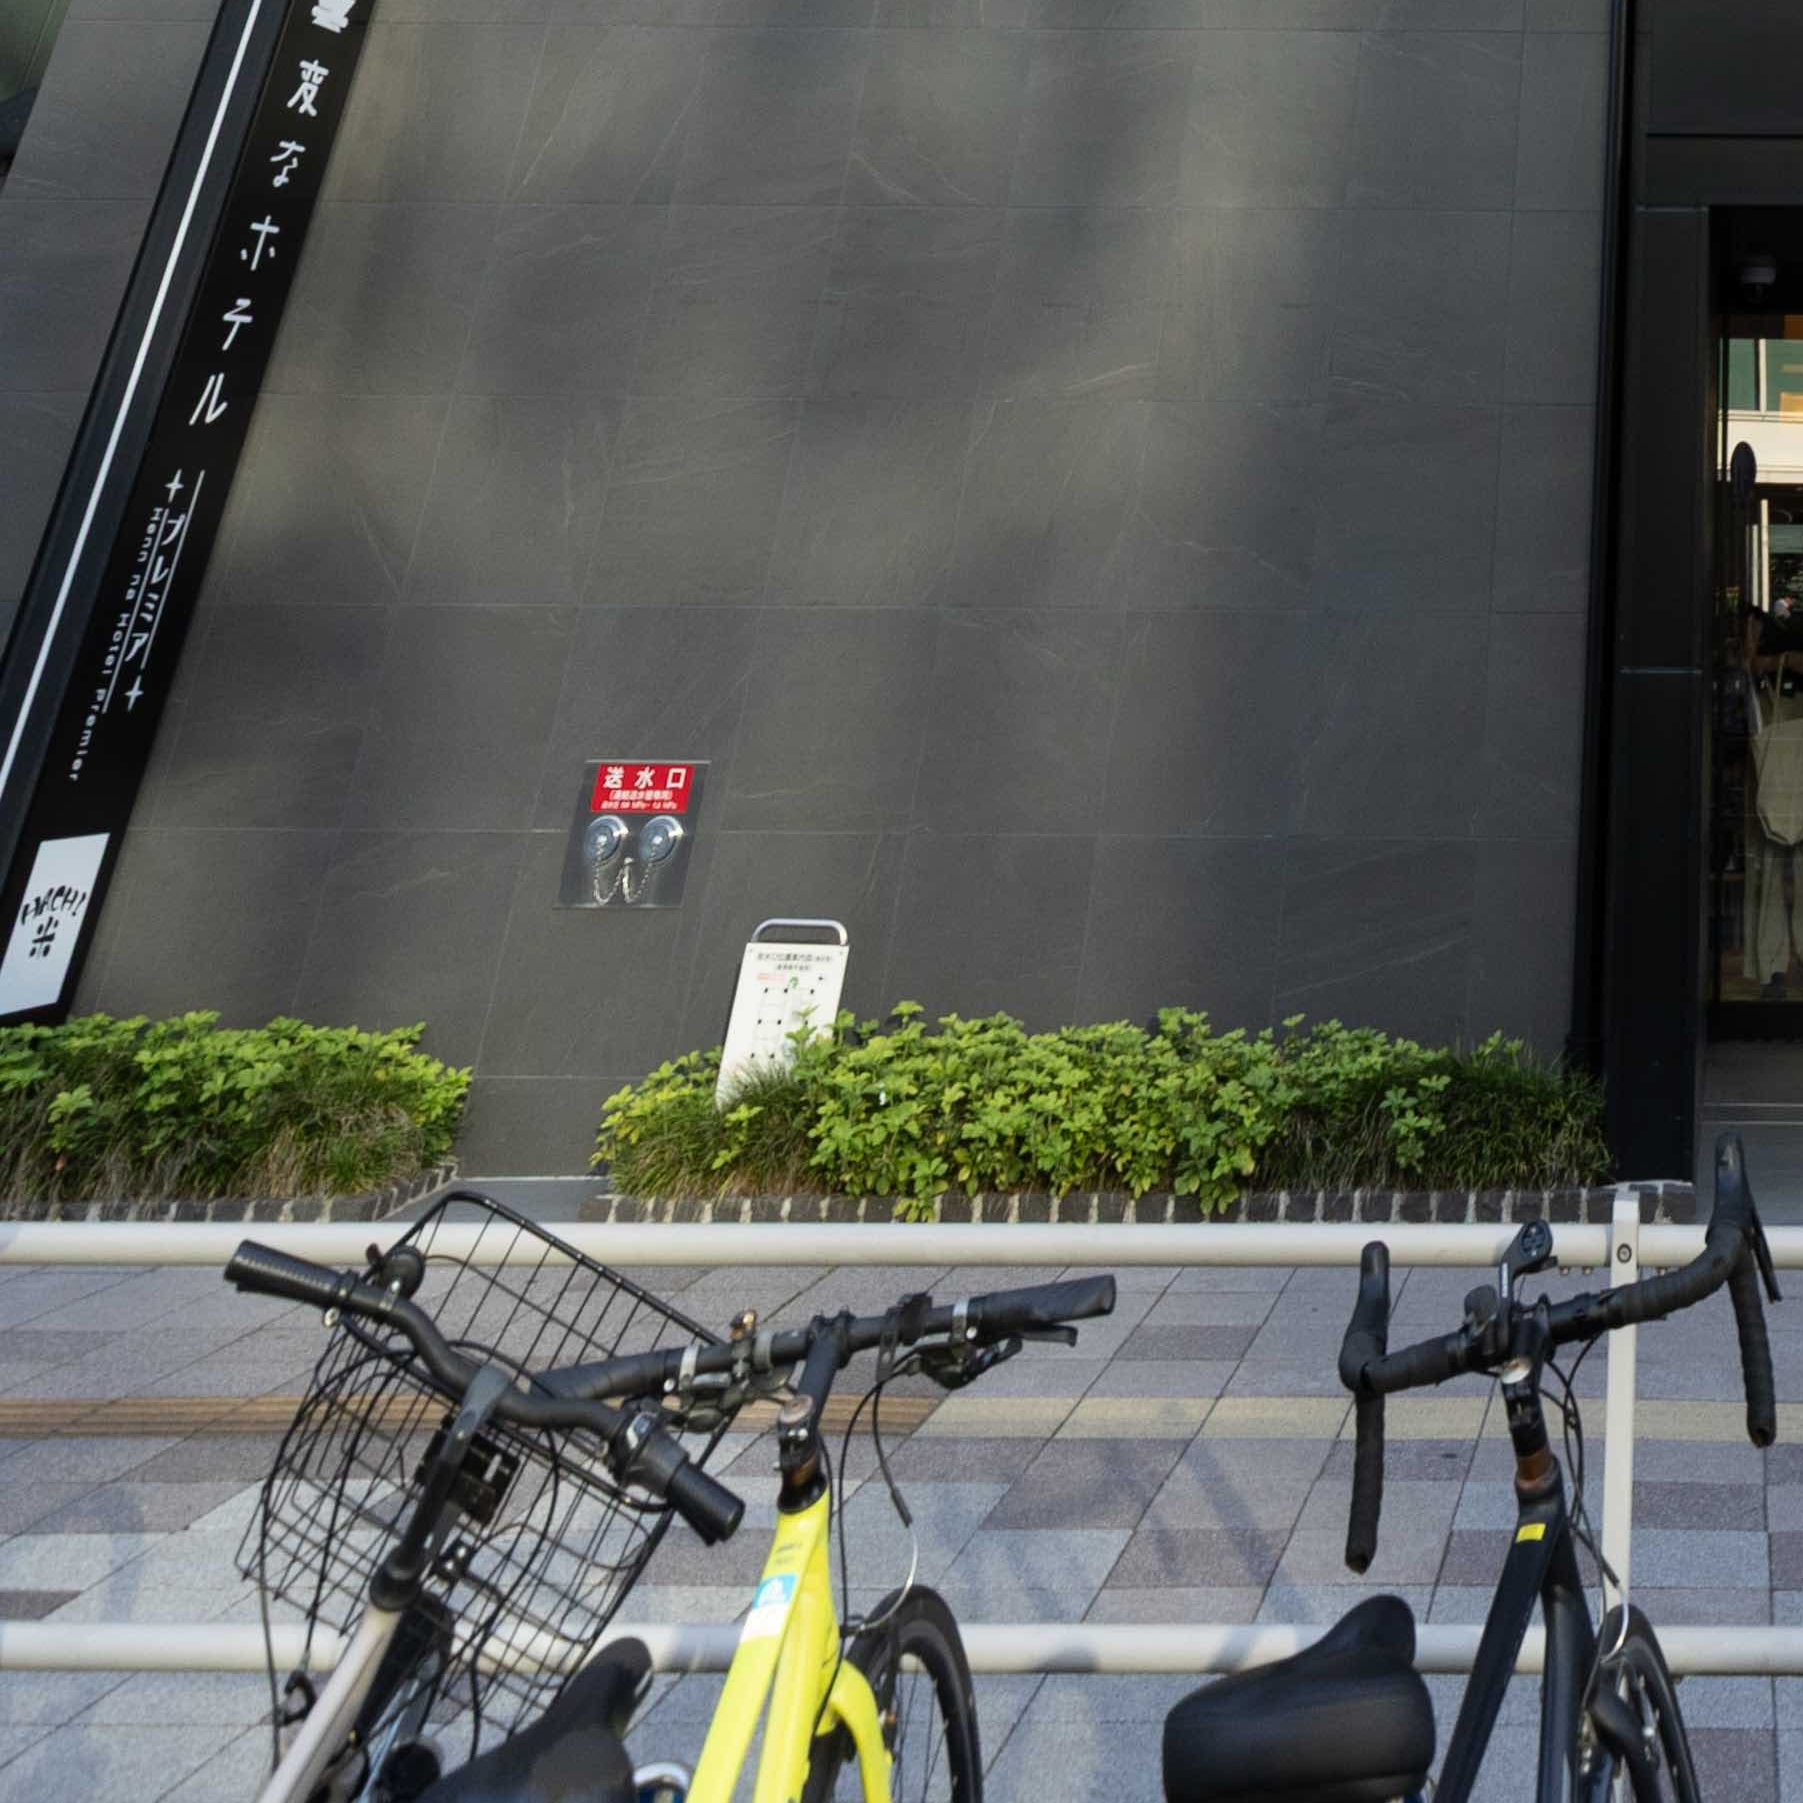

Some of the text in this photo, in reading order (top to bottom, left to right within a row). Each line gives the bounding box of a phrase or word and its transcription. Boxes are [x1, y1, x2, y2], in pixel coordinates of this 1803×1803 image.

[189, 59, 329, 426] 変なホテル
[68, 506, 164, 782] Henn na Hotel Premier
[125, 513, 186, 662] プレミア
[603, 766, 687, 789] 送水口
